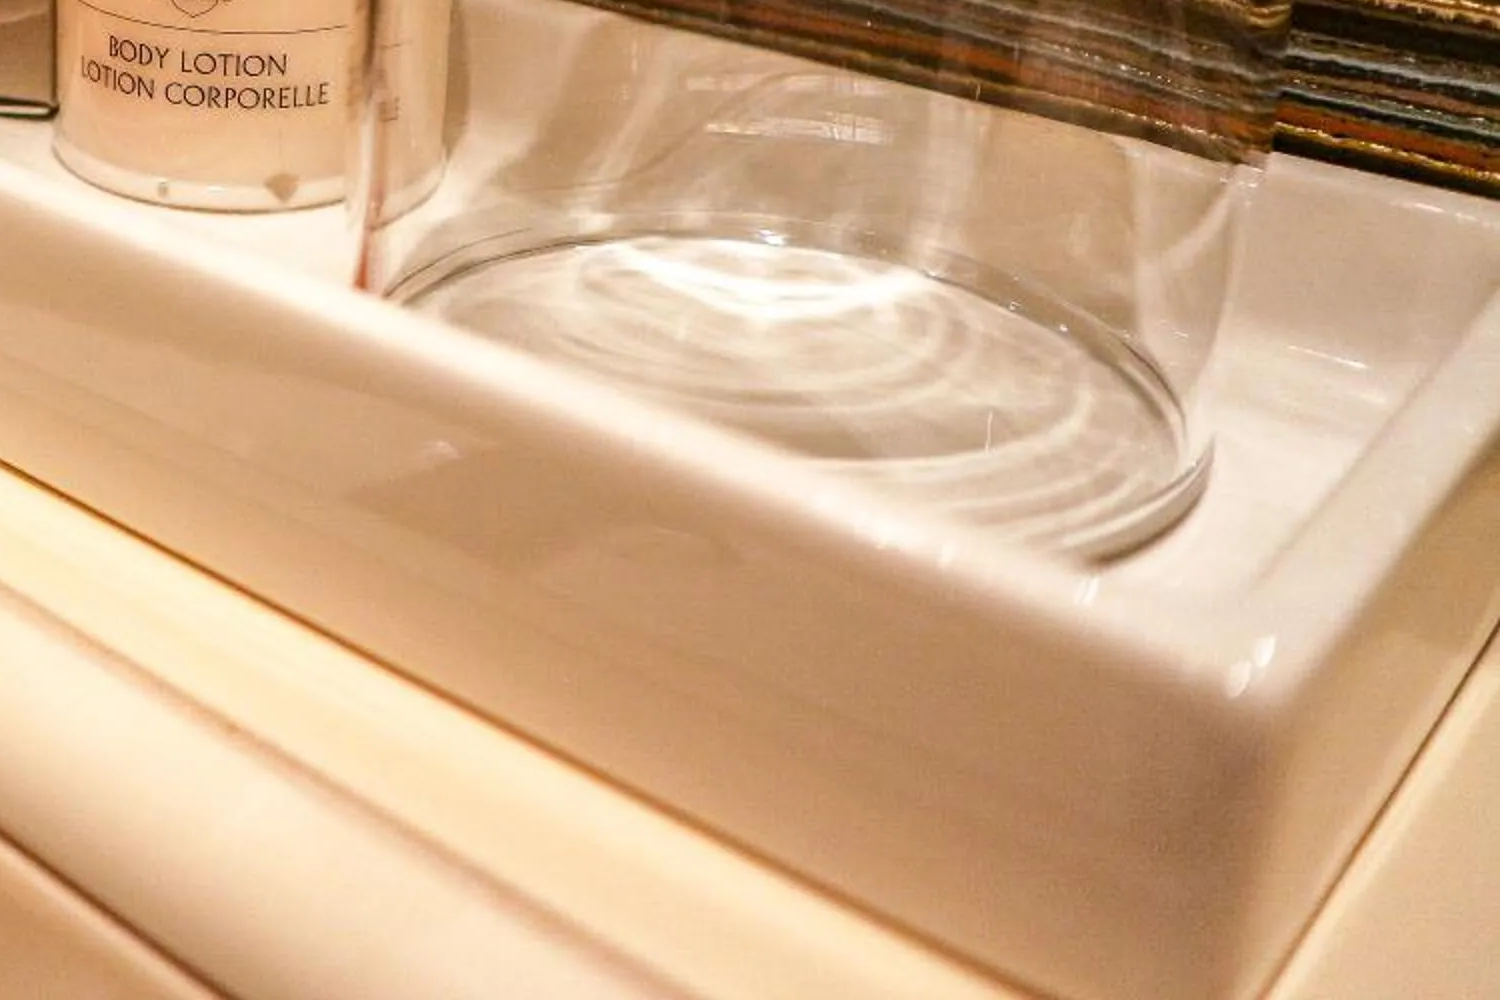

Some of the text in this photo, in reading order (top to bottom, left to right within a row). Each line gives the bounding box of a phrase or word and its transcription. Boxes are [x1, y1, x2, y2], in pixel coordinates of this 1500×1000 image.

[108, 35, 288, 77] BODY LOTION
[81, 55, 331, 110] LOTION CORPORELLE
